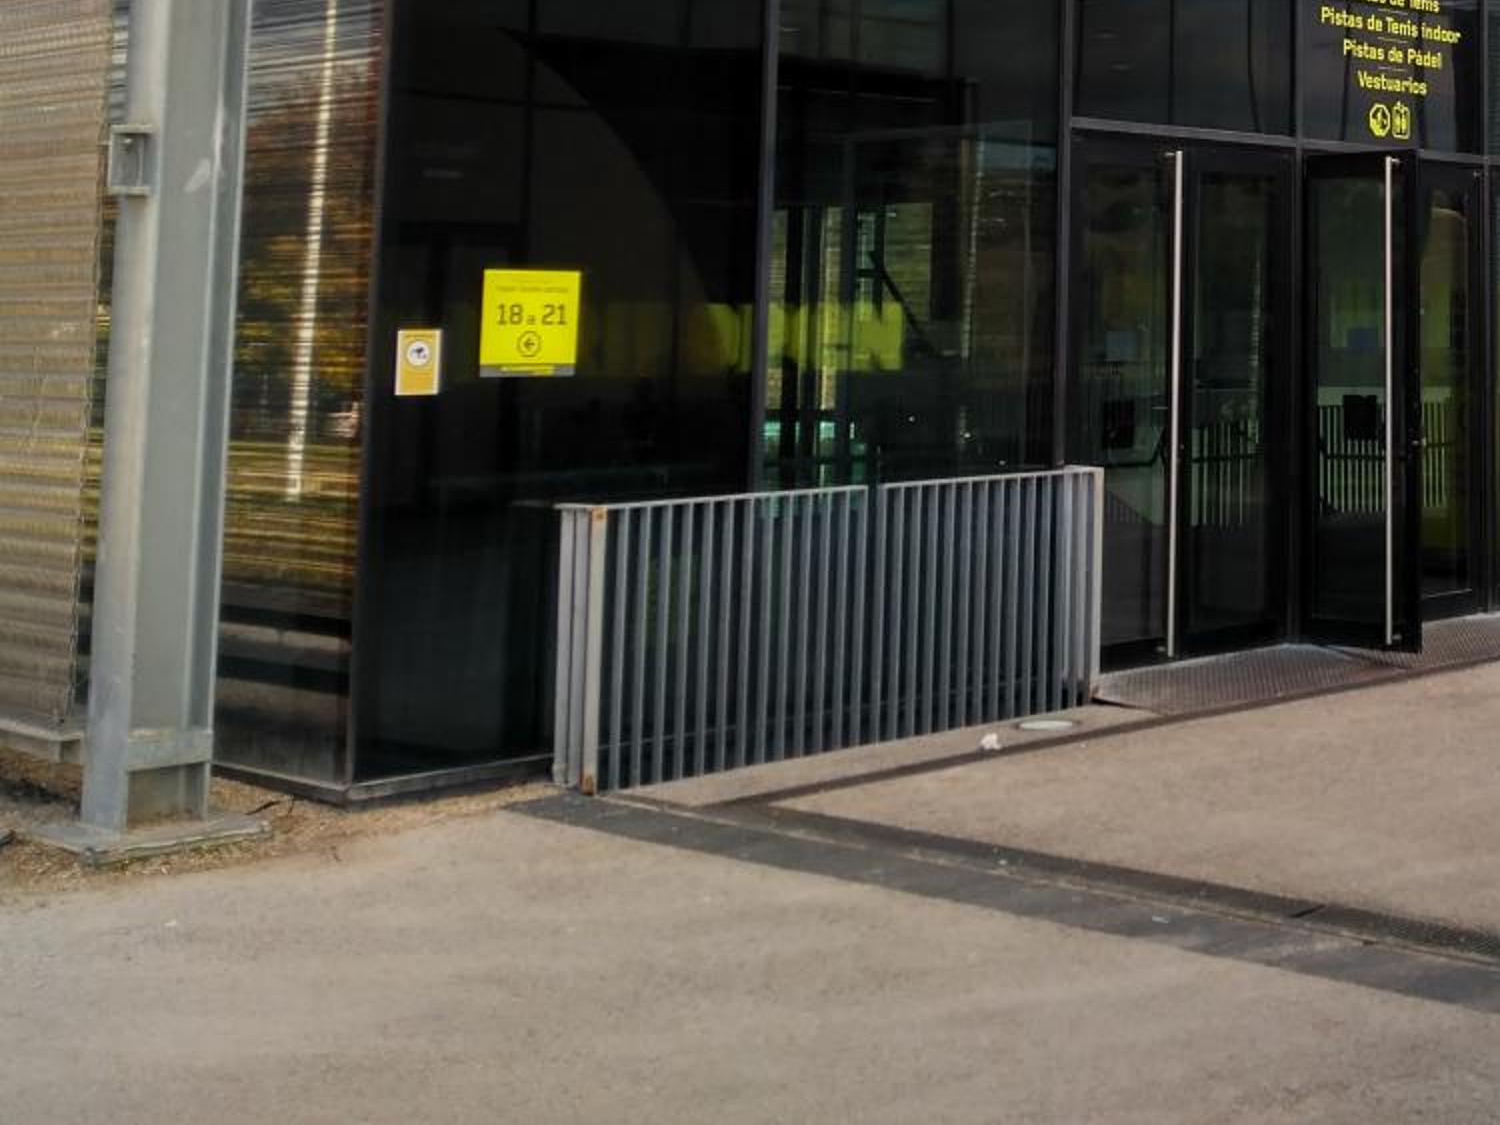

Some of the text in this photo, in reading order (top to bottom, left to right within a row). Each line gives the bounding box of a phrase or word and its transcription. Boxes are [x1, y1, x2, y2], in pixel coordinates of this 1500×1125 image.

[1320, 6, 1462, 44] Pistas de Tenis indoor
[1343, 38, 1385, 61] Pistas
[1388, 46, 1403, 64] de
[1357, 70, 1428, 96] Vestuarios
[497, 303, 524, 326] 18
[541, 303, 568, 326] 21
